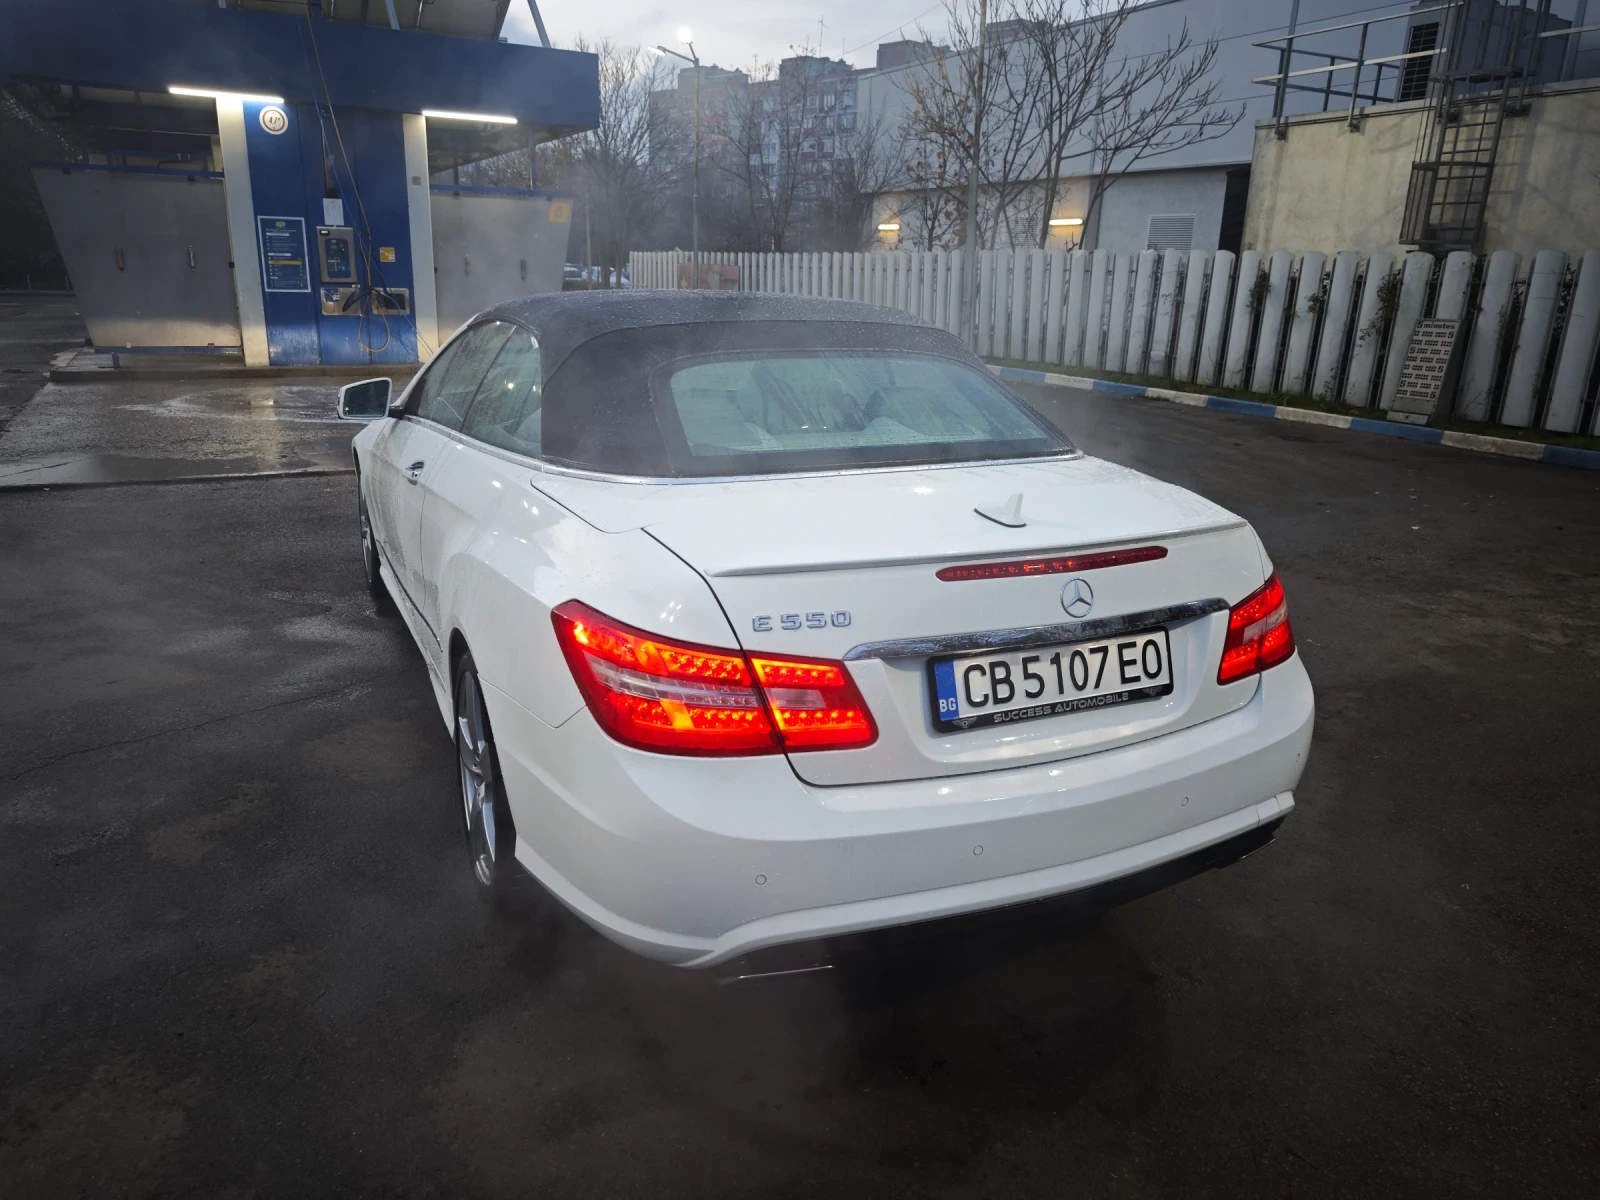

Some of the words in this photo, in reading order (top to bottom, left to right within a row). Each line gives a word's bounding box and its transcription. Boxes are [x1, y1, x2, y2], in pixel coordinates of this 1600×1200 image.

[752, 615, 773, 632] E
[780, 609, 852, 631] 550
[963, 660, 1015, 708] CB
[1021, 645, 1109, 699] 5107
[939, 697, 957, 713] BG
[993, 705, 1052, 723] SUCCESS
[1055, 692, 1129, 712] AUTOMOBILE
